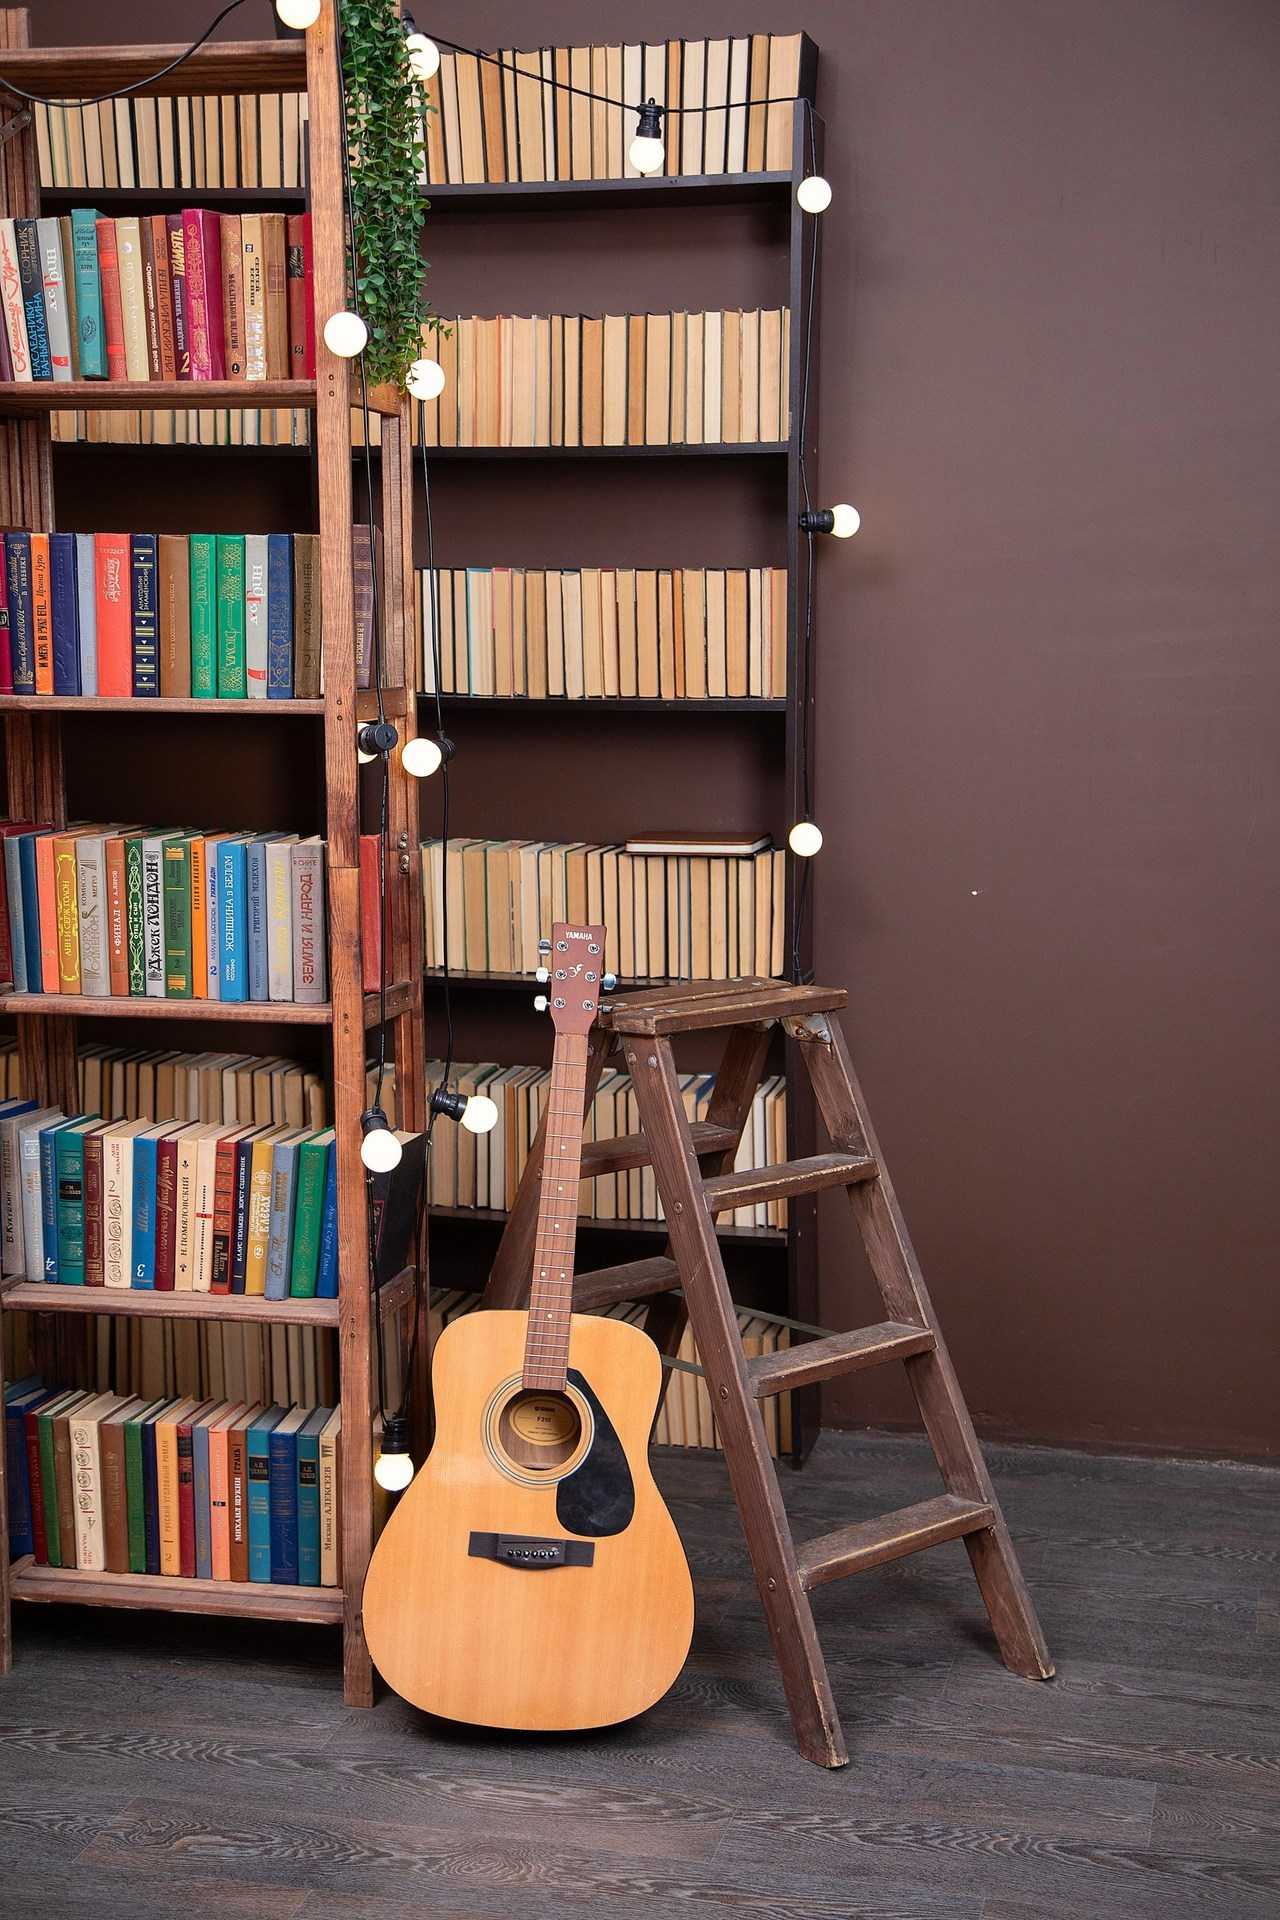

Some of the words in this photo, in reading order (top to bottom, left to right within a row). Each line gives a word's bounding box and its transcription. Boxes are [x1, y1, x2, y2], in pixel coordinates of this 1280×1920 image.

[18, 227, 32, 284] СБОРНИК
[171, 228, 185, 276] ПАМЯТЬ
[34, 292, 46, 328] КАИНА
[158, 269, 172, 352] ВЕРШАЛИНСКИЙ
[165, 355, 173, 373] РАЙ
[26, 301, 41, 376] НАСЛЕДНИКИ
[36, 328, 50, 376] ВАНЬКИ
[180, 352, 189, 373] 2
[35, 554, 46, 571] Гуро
[35, 572, 44, 597] Ирина
[37, 616, 47, 632] РУКЕ
[38, 642, 48, 660] МЕРА
[304, 653, 311, 667] 2
[225, 856, 233, 889] БЕЛОМ
[145, 862, 160, 925] ЛОНДОН
[272, 860, 290, 918] Кристи
[300, 873, 313, 920] НАРОД
[225, 898, 234, 951] ЖЕНЩИНА
[302, 925, 313, 933] И
[565, 932, 592, 940] YAMAHA
[83, 926, 92, 961] ЖОРЖ
[91, 914, 100, 971] СИМЕНОН
[148, 928, 161, 970] Джек
[174, 959, 180, 968] 2
[210, 966, 217, 976] 2
[302, 935, 314, 984] ЗЕМЛЯ
[109, 1181, 115, 1192] 2
[260, 1195, 270, 1224] ЛЕСАХ
[45, 1257, 55, 1270] 4
[256, 1248, 261, 1256] 2
[138, 1264, 145, 1277] 3
[87, 1517, 95, 1529] 4
